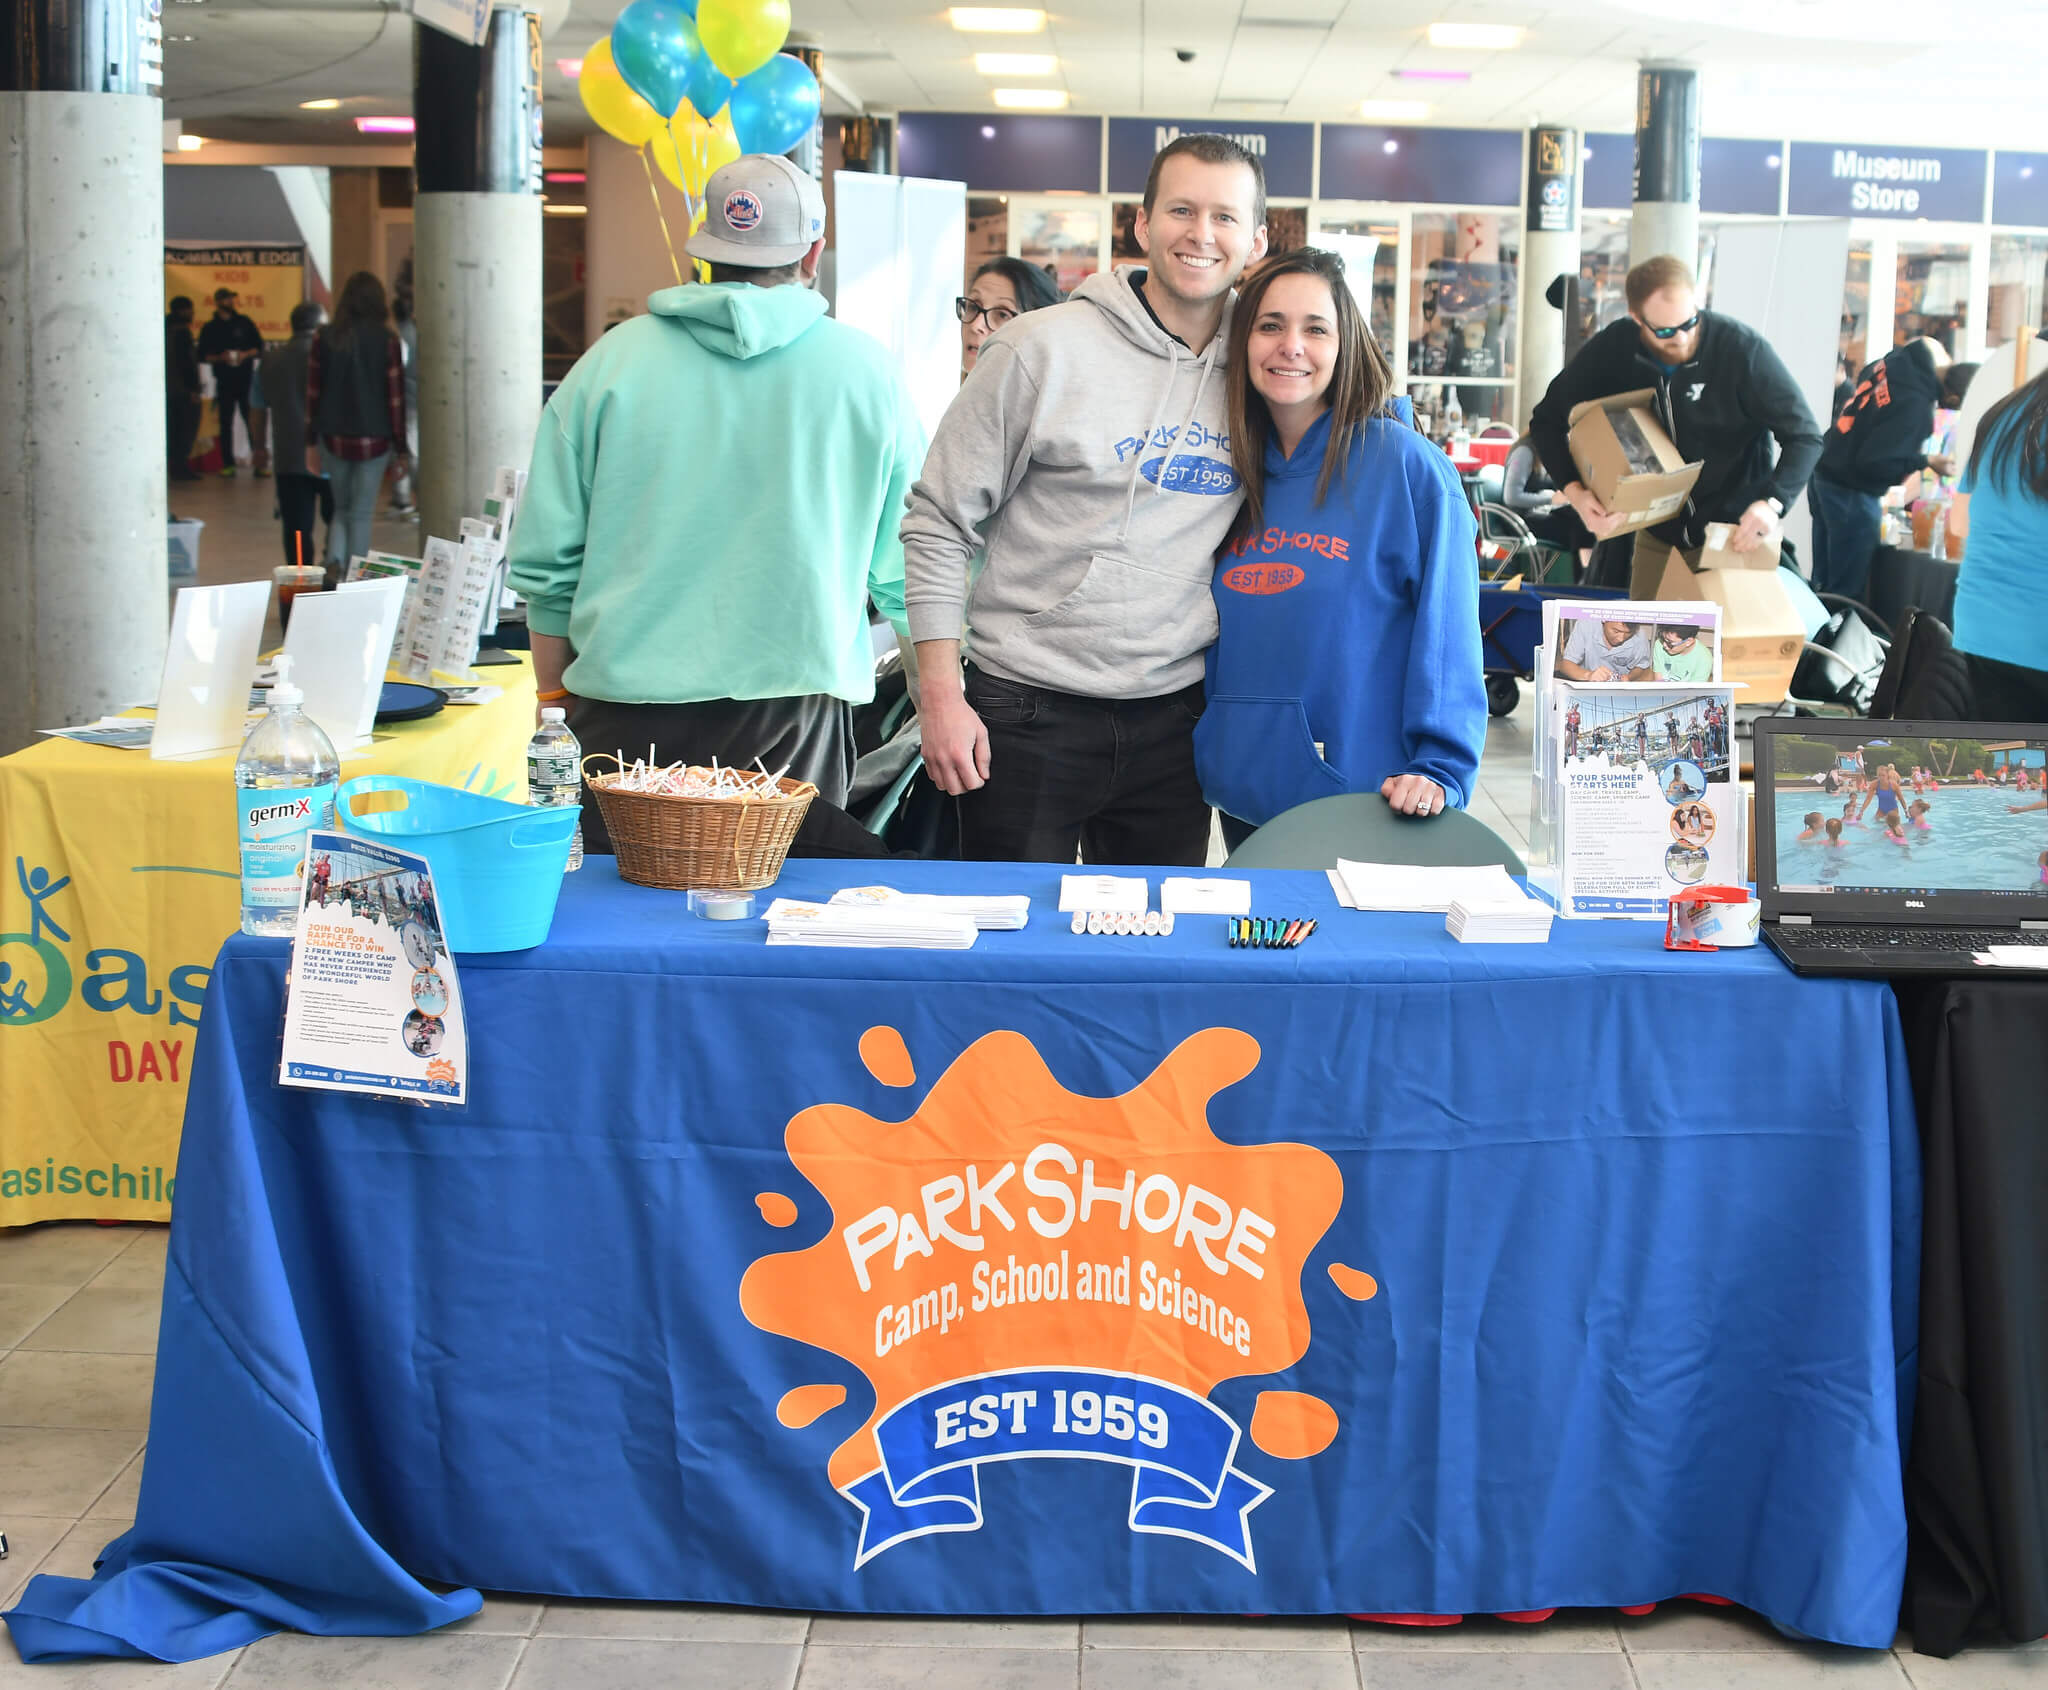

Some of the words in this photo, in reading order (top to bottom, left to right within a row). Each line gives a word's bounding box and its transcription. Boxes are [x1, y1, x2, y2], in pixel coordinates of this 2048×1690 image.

[1155, 126, 1267, 156] Mum
[1833, 150, 1941, 182] Museum
[1852, 181, 1919, 212] Store
[204, 295, 264, 308] ALTS
[1185, 421, 1232, 452] SHO
[1191, 466, 1233, 489] 1959
[1261, 527, 1350, 561] SHORE
[1230, 569, 1263, 588] EST
[1266, 568, 1294, 585] 1959
[250, 798, 310, 827] germ-X
[1905, 900, 1926, 908] DELL
[307, 930, 343, 941] RAFFLE
[346, 935, 366, 943] FOR
[308, 924, 331, 932] JOIN
[334, 926, 354, 934] OUR
[306, 939, 347, 949] CHANCE
[349, 942, 362, 950] TO
[365, 944, 384, 952] WIN
[334, 950, 361, 958] WEEKS
[376, 954, 396, 962] CAMP
[346, 958, 374, 966] CAMPER
[318, 969, 362, 979] WONDERFUL
[365, 974, 390, 982] WORLD
[319, 963, 343, 971] NEVER
[345, 965, 392, 975] EXPERIENCED
[313, 975, 332, 983] PARK
[335, 977, 358, 985] SHORE
[108, 1040, 183, 1083] DAY
[875, 1281, 964, 1357] Camp,
[972, 1250, 1069, 1312] School
[1076, 1256, 1130, 1306] and
[1139, 1260, 1251, 1357] Science
[933, 1390, 1037, 1449] EST
[1052, 1390, 1169, 1449] 1959
